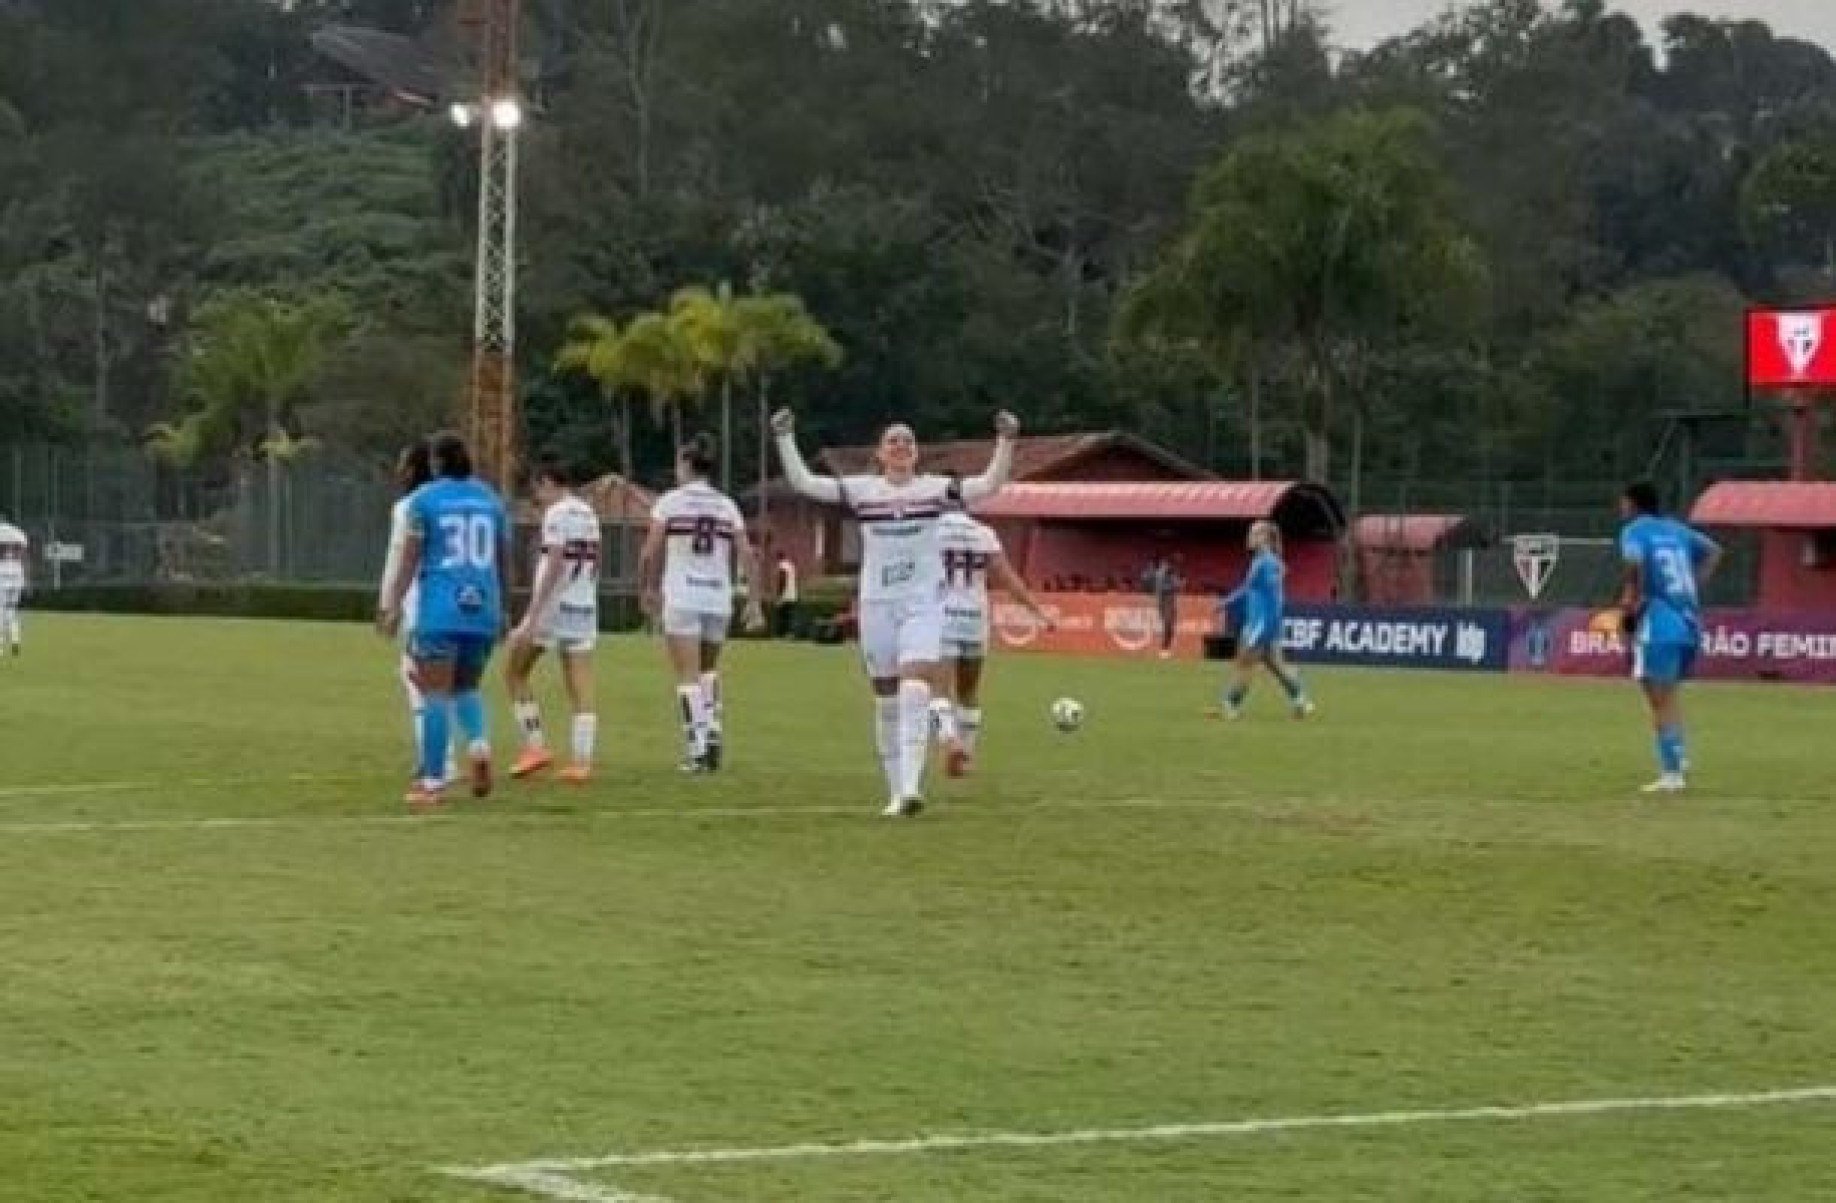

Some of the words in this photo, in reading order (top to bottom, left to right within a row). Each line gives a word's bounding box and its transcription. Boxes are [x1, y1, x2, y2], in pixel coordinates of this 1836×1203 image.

[438, 513, 494, 568] 30
[692, 515, 714, 554] 8
[1280, 617, 1323, 648] CBF
[1326, 619, 1449, 656] ACADEMY
